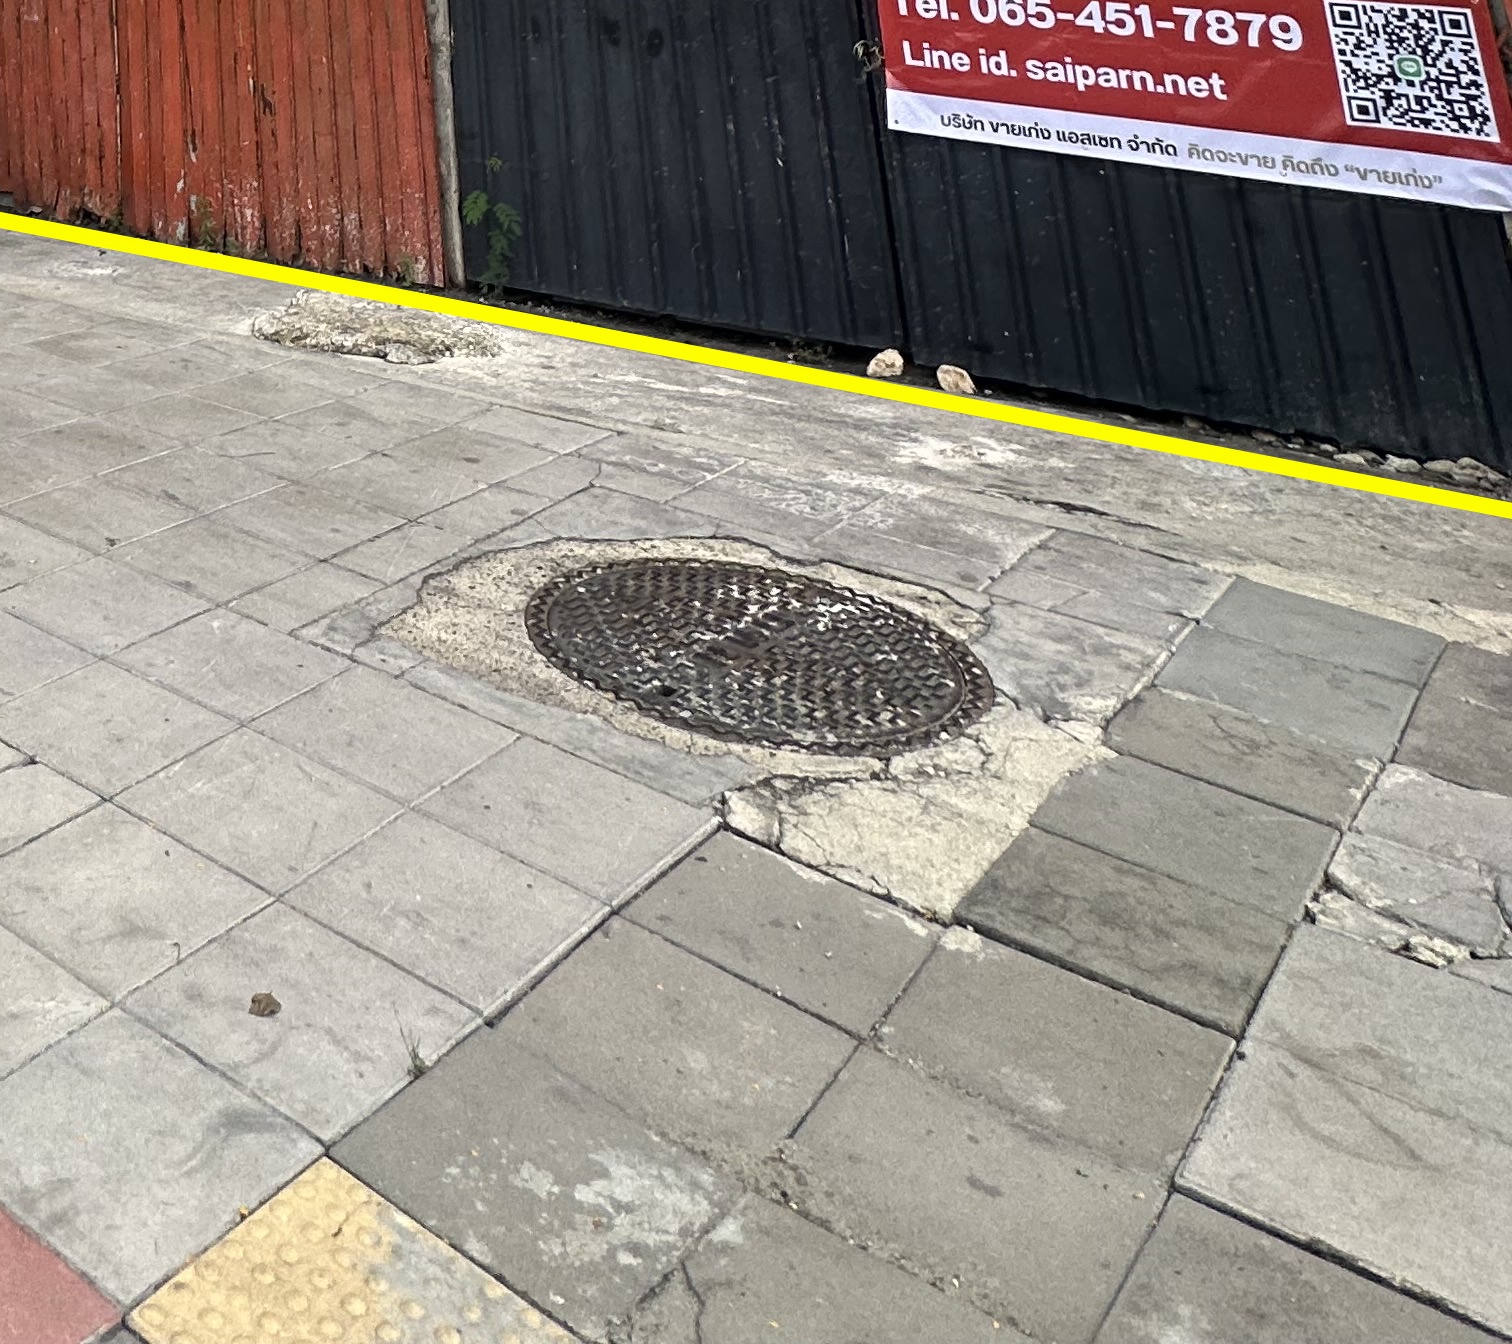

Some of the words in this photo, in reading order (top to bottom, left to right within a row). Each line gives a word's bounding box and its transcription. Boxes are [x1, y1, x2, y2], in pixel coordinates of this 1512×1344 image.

[902, 39, 972, 73] Line
[979, 47, 1018, 78] id.
[1025, 56, 1228, 101] saiparn.net
[940, 113, 985, 132] บริษัท
[989, 121, 1052, 140] ขายเก่ง
[1126, 134, 1178, 157] จำกัด
[1188, 143, 1276, 170] คิดจะขาย
[1281, 154, 1339, 177] คิดถึง
